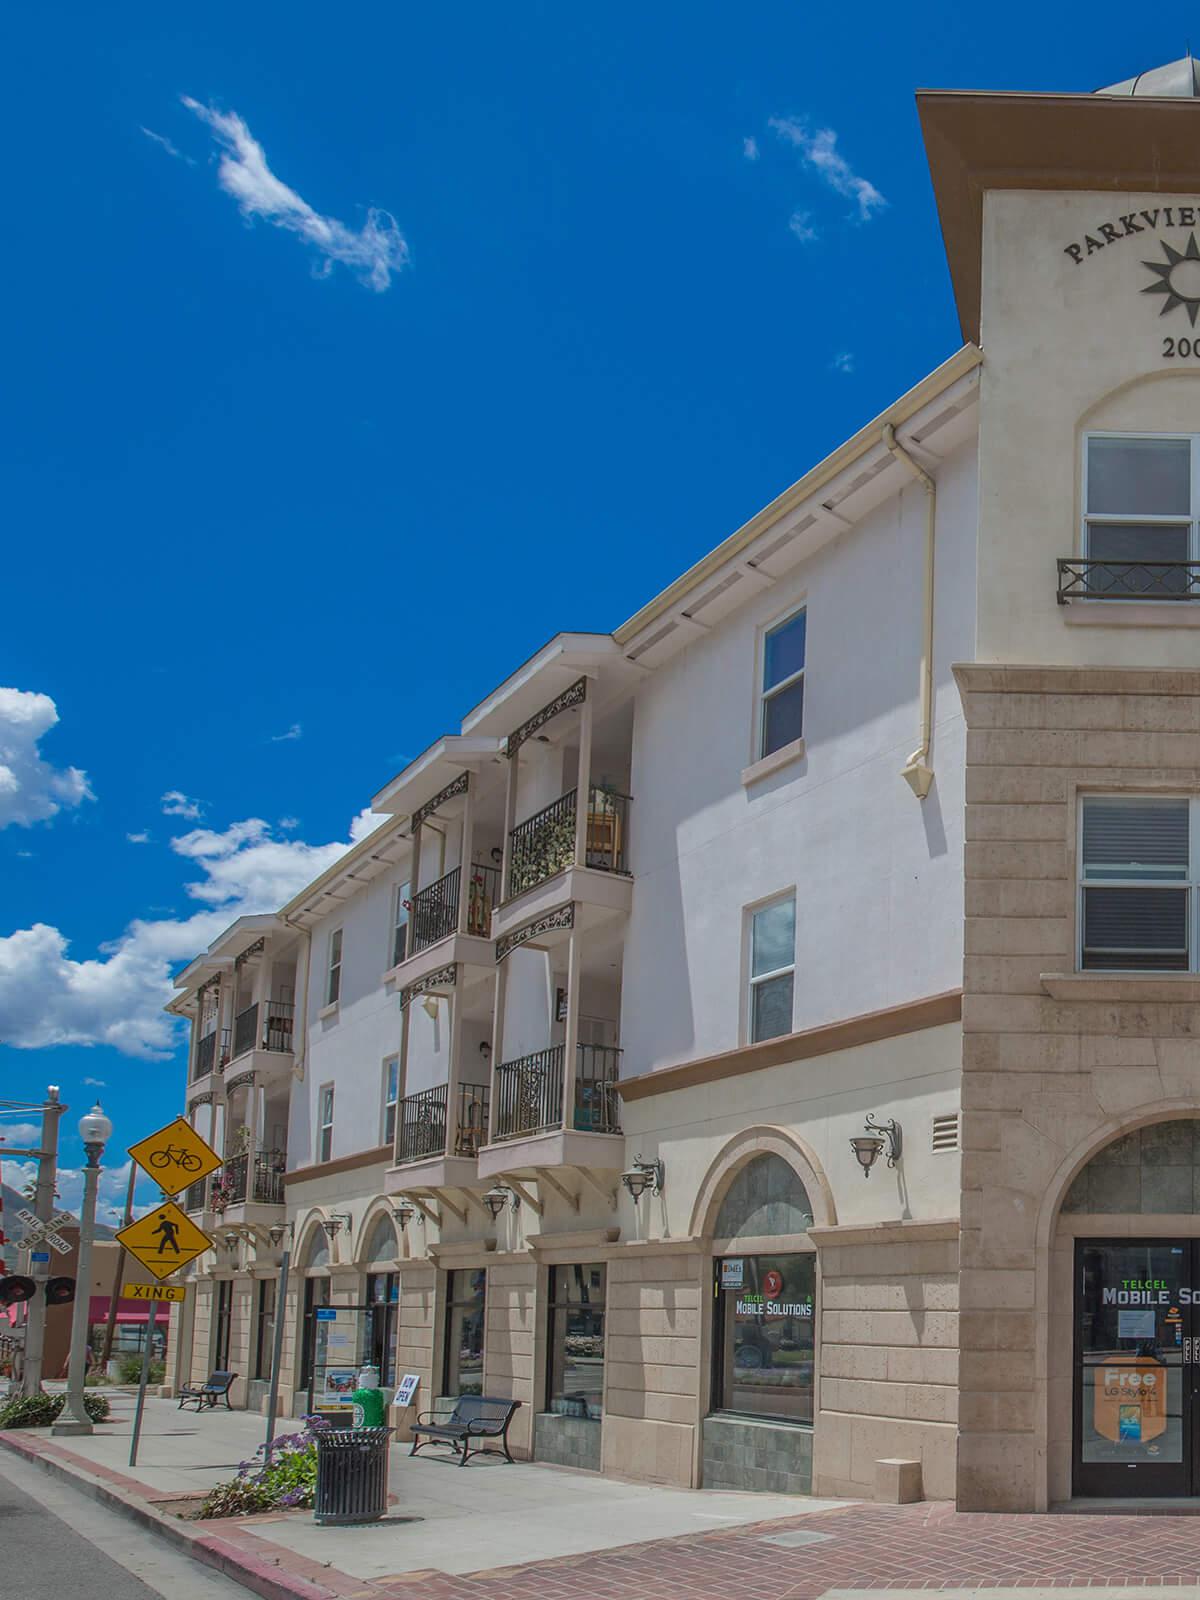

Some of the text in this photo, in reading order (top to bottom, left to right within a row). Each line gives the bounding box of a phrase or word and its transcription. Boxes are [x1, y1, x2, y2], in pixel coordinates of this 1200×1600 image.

[19, 1210, 70, 1253] RAIL ROAD
[1122, 1279, 1168, 1290] TELCEL
[134, 1286, 175, 1300] XING
[1102, 1287, 1170, 1305] MOBILE
[736, 1301, 812, 1316] MOBILE SOLUTIONS
[1104, 1369, 1157, 1386] Free
[1104, 1387, 1119, 1396] LG
